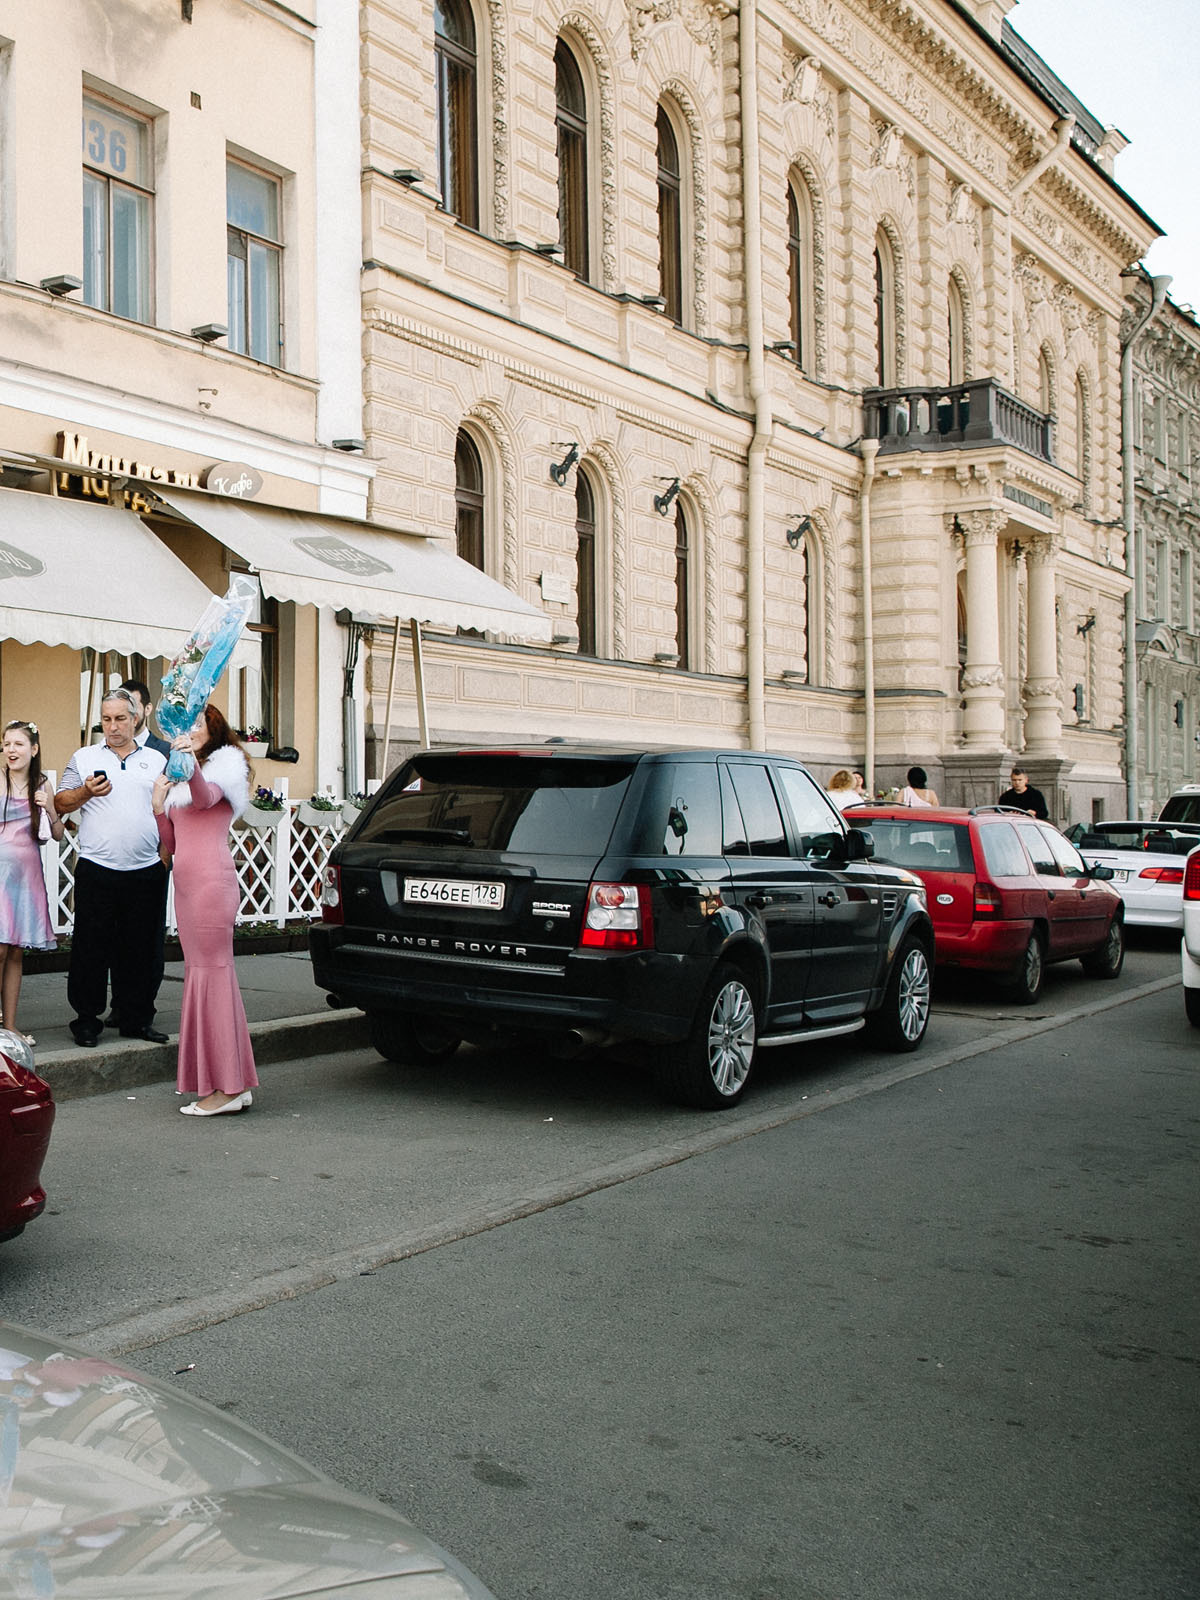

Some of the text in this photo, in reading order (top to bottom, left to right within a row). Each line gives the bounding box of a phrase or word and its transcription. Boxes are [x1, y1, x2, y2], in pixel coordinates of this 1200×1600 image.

[83, 117, 127, 173] 36
[474, 885, 498, 900] 178
[532, 901, 572, 911] SPORT
[376, 933, 528, 957] RANGE ROVER
